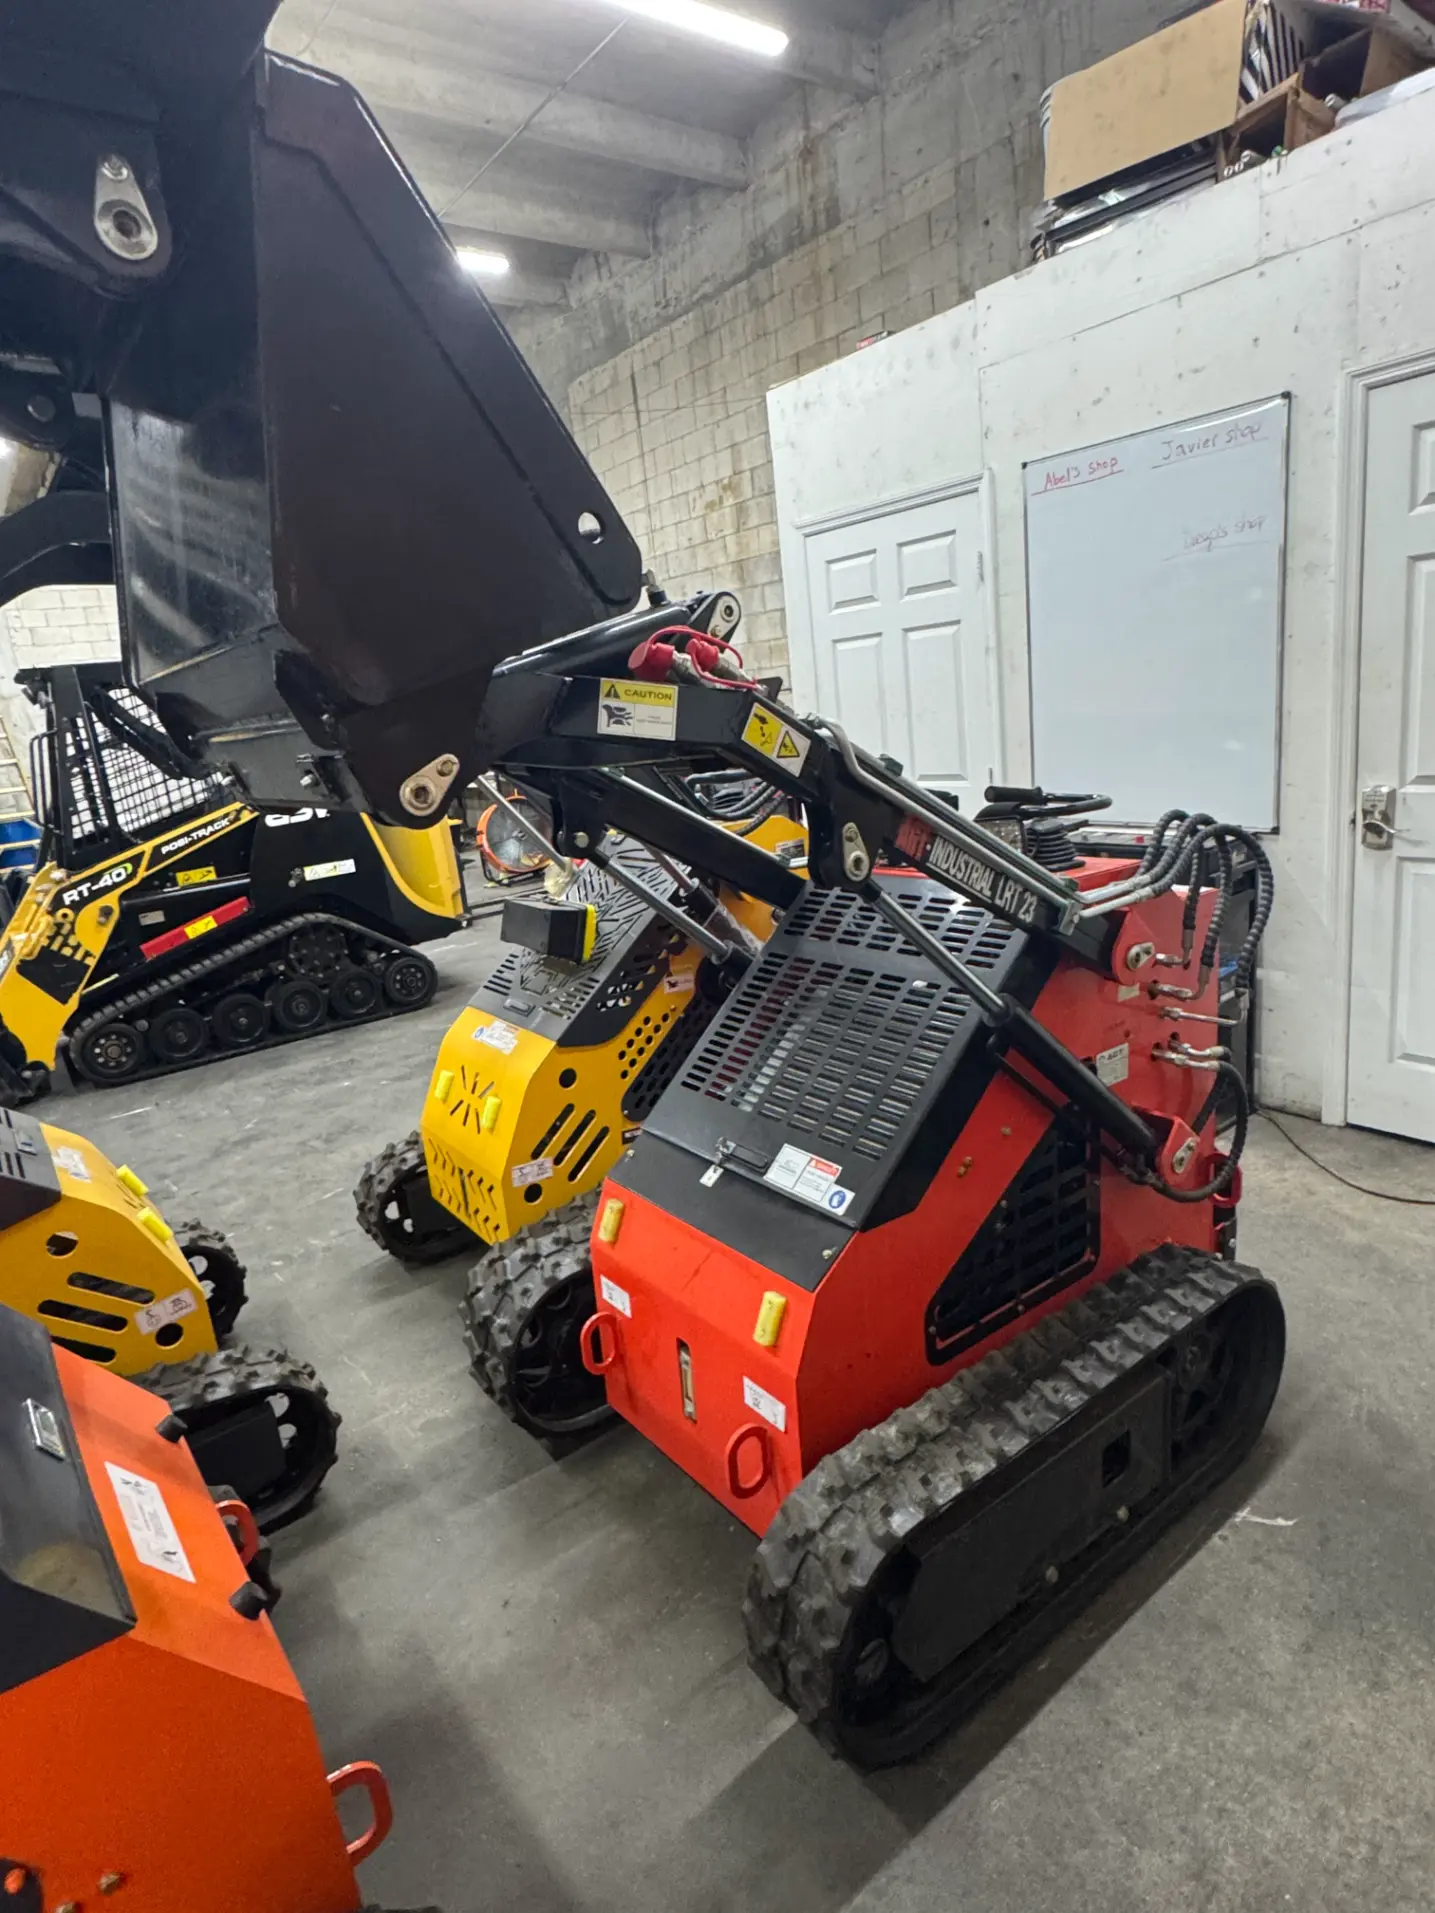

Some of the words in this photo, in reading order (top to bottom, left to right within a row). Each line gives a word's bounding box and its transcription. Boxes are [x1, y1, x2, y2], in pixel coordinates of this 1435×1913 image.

[1161, 434, 1219, 460] Javier
[624, 689, 672, 701] CAUTION
[161, 818, 230, 855] POSI-TRACK
[62, 867, 127, 906] RT-40
[928, 836, 996, 898] INDUSTRIAL
[994, 875, 1024, 914] LRT
[1017, 891, 1038, 923] 23
